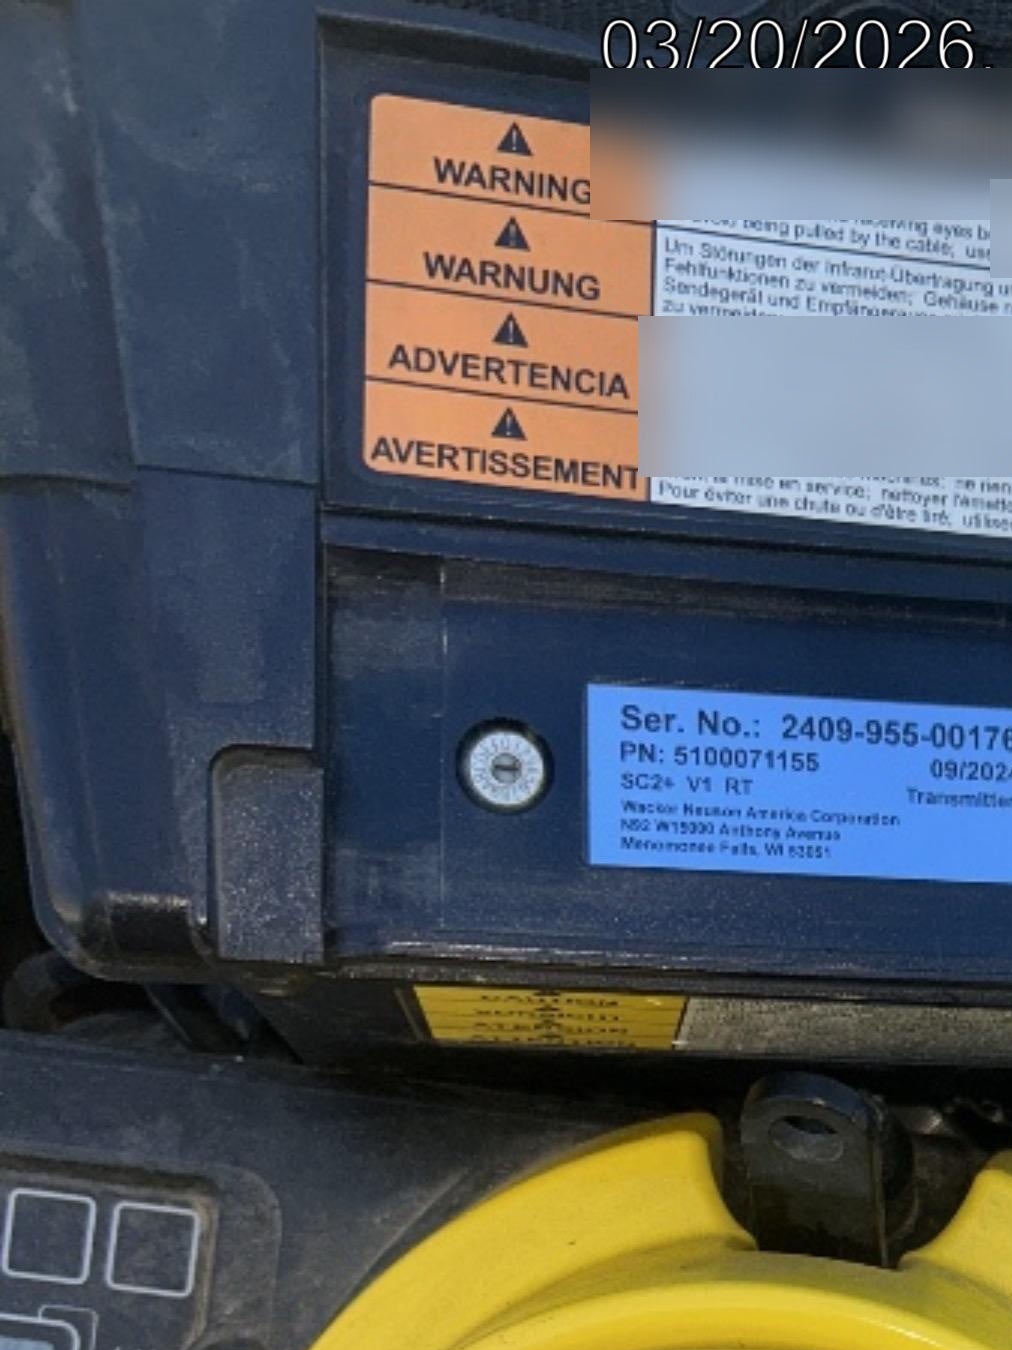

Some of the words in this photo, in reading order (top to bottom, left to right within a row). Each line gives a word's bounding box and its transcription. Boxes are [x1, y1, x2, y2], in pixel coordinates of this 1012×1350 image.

[424, 251, 600, 302] WARNUNG
[388, 343, 631, 400] ADVERTENCIA
[370, 436, 638, 491] AVERTISSEMENT
[620, 703, 685, 734] Ser.
[697, 709, 761, 739] No.:
[620, 740, 665, 765] PN:
[673, 745, 820, 773] 5100071155
[620, 772, 675, 793] SC2+
[686, 775, 712, 793] V1
[724, 777, 754, 796] RT
